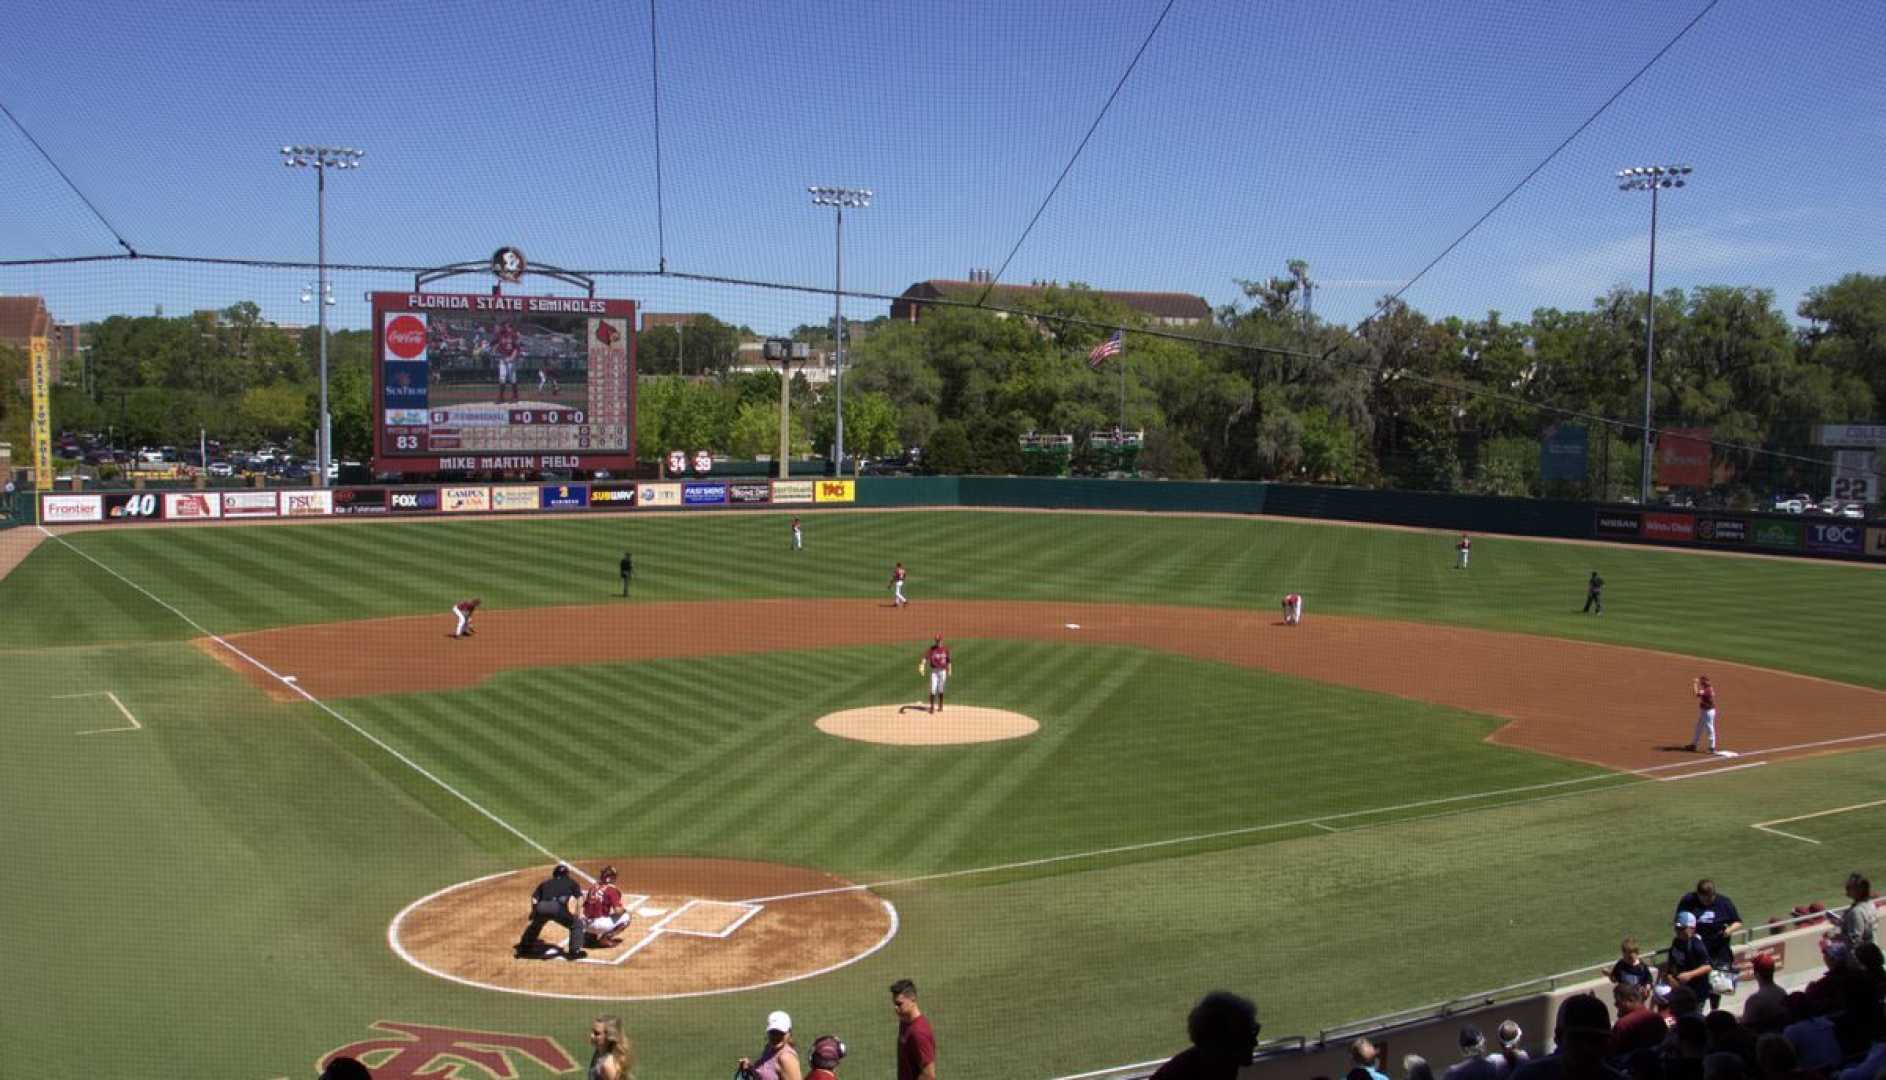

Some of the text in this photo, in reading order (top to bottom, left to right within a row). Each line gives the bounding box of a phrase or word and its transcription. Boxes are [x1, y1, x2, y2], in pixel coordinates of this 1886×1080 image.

[408, 295, 606, 313] FLORIDA STATE SEMINOLES
[523, 411, 532, 423] 0
[548, 411, 558, 423] 0
[574, 411, 583, 423] 0
[397, 435, 419, 449] 83
[439, 456, 580, 470] MIKE MARTIN FIELD
[670, 456, 686, 471] 34
[448, 489, 484, 498] CAMPUS
[591, 490, 635, 501] SUBWAY
[1835, 478, 1868, 500] 22
[124, 494, 156, 515] 40
[289, 496, 311, 507] FSU
[392, 495, 418, 507] FOX
[48, 503, 96, 514] Frontier
[1600, 519, 1638, 528] NISSAN
[1815, 525, 1855, 543] TOC
